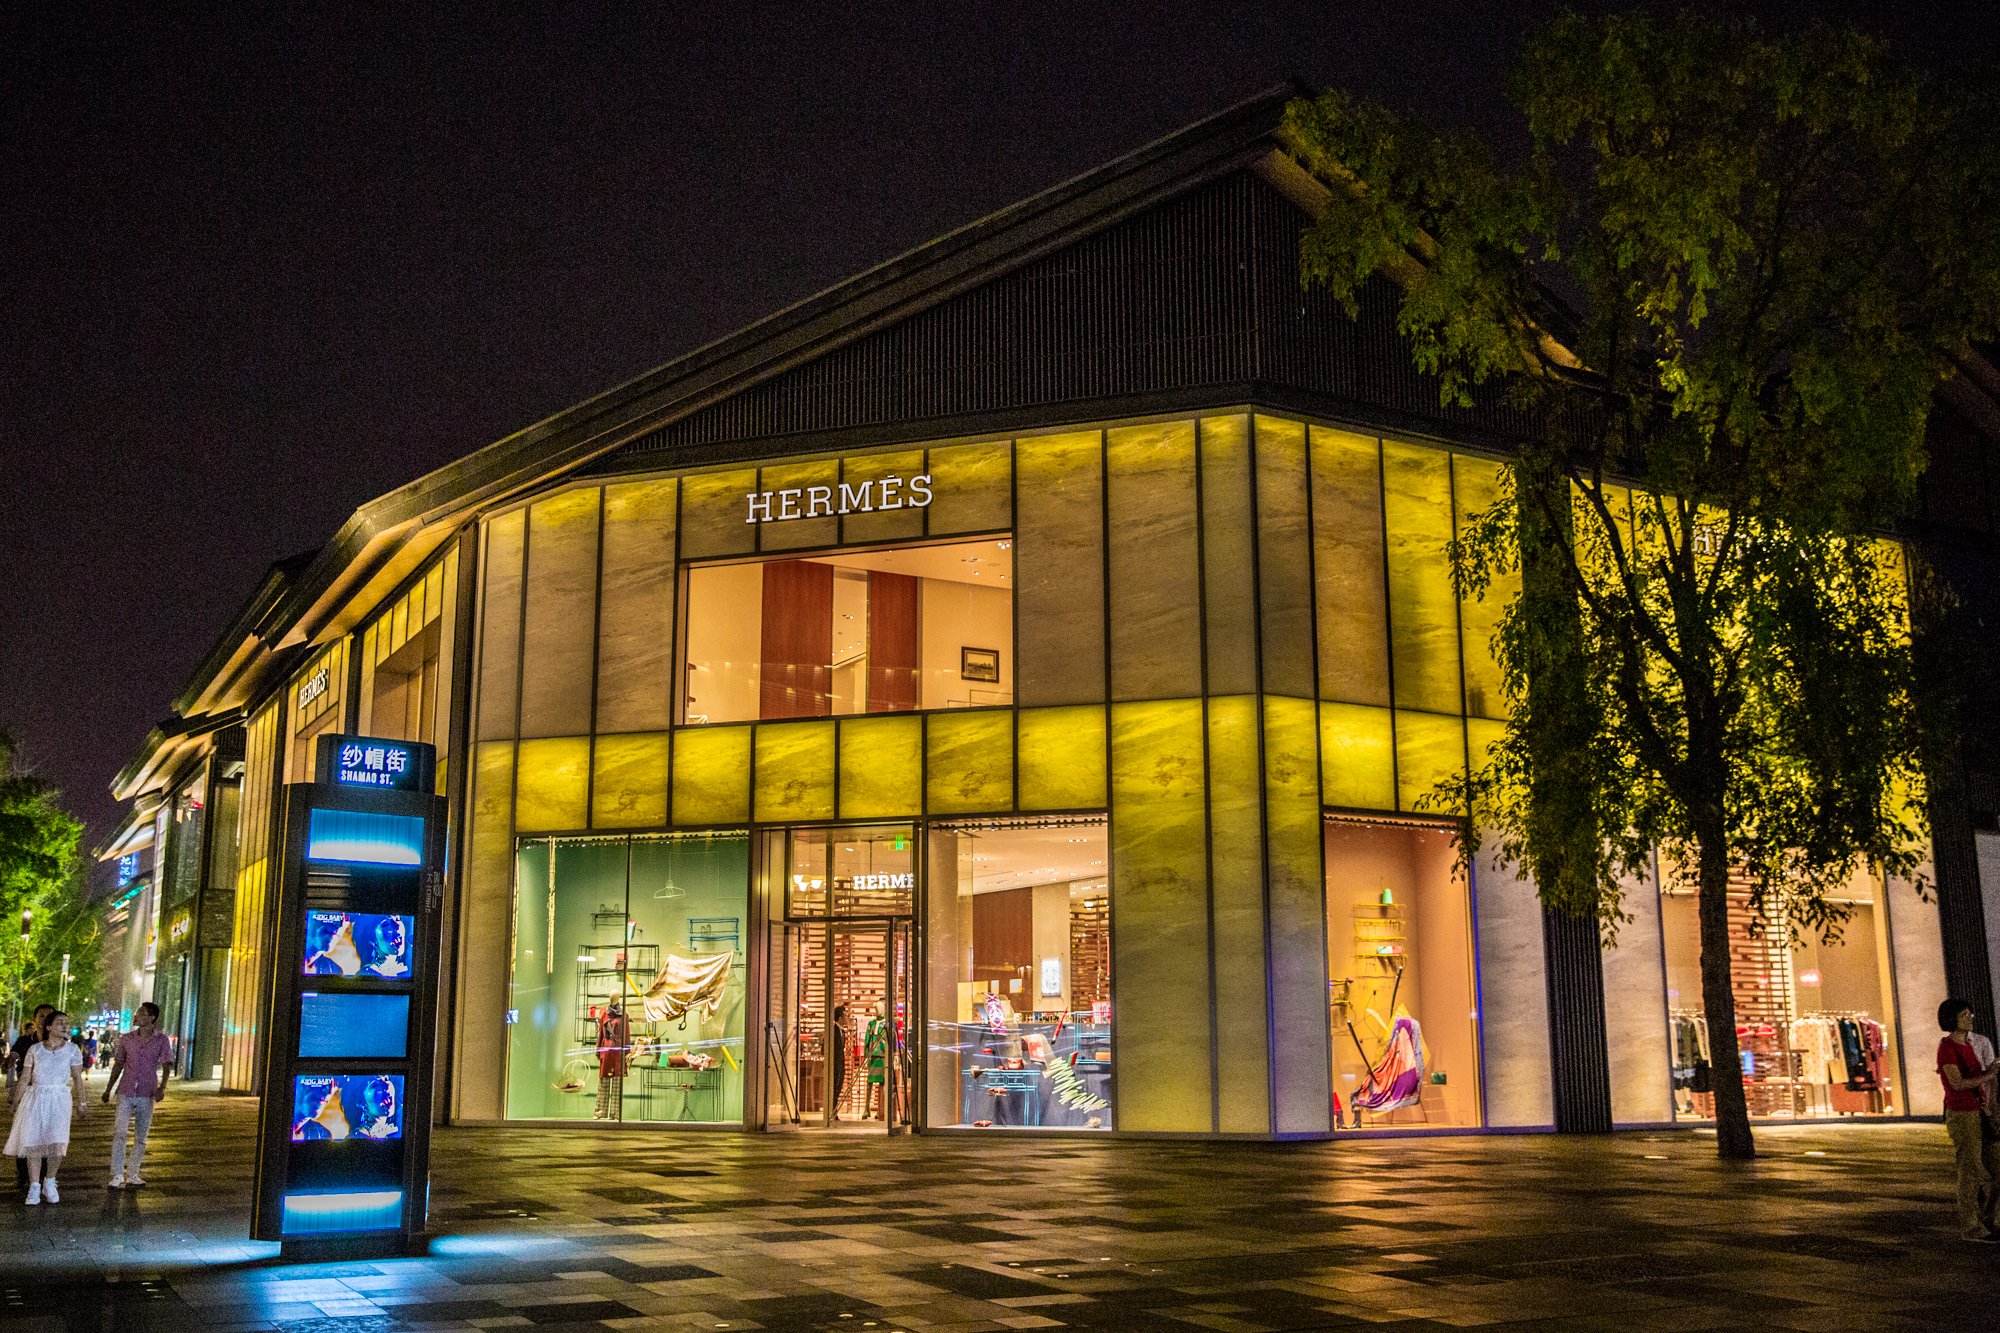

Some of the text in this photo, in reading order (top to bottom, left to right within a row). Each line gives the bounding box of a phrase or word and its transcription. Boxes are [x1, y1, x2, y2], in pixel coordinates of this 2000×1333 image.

[342, 745, 407, 772] 纱帽街
[341, 770, 394, 786] SHAMAO ST.
